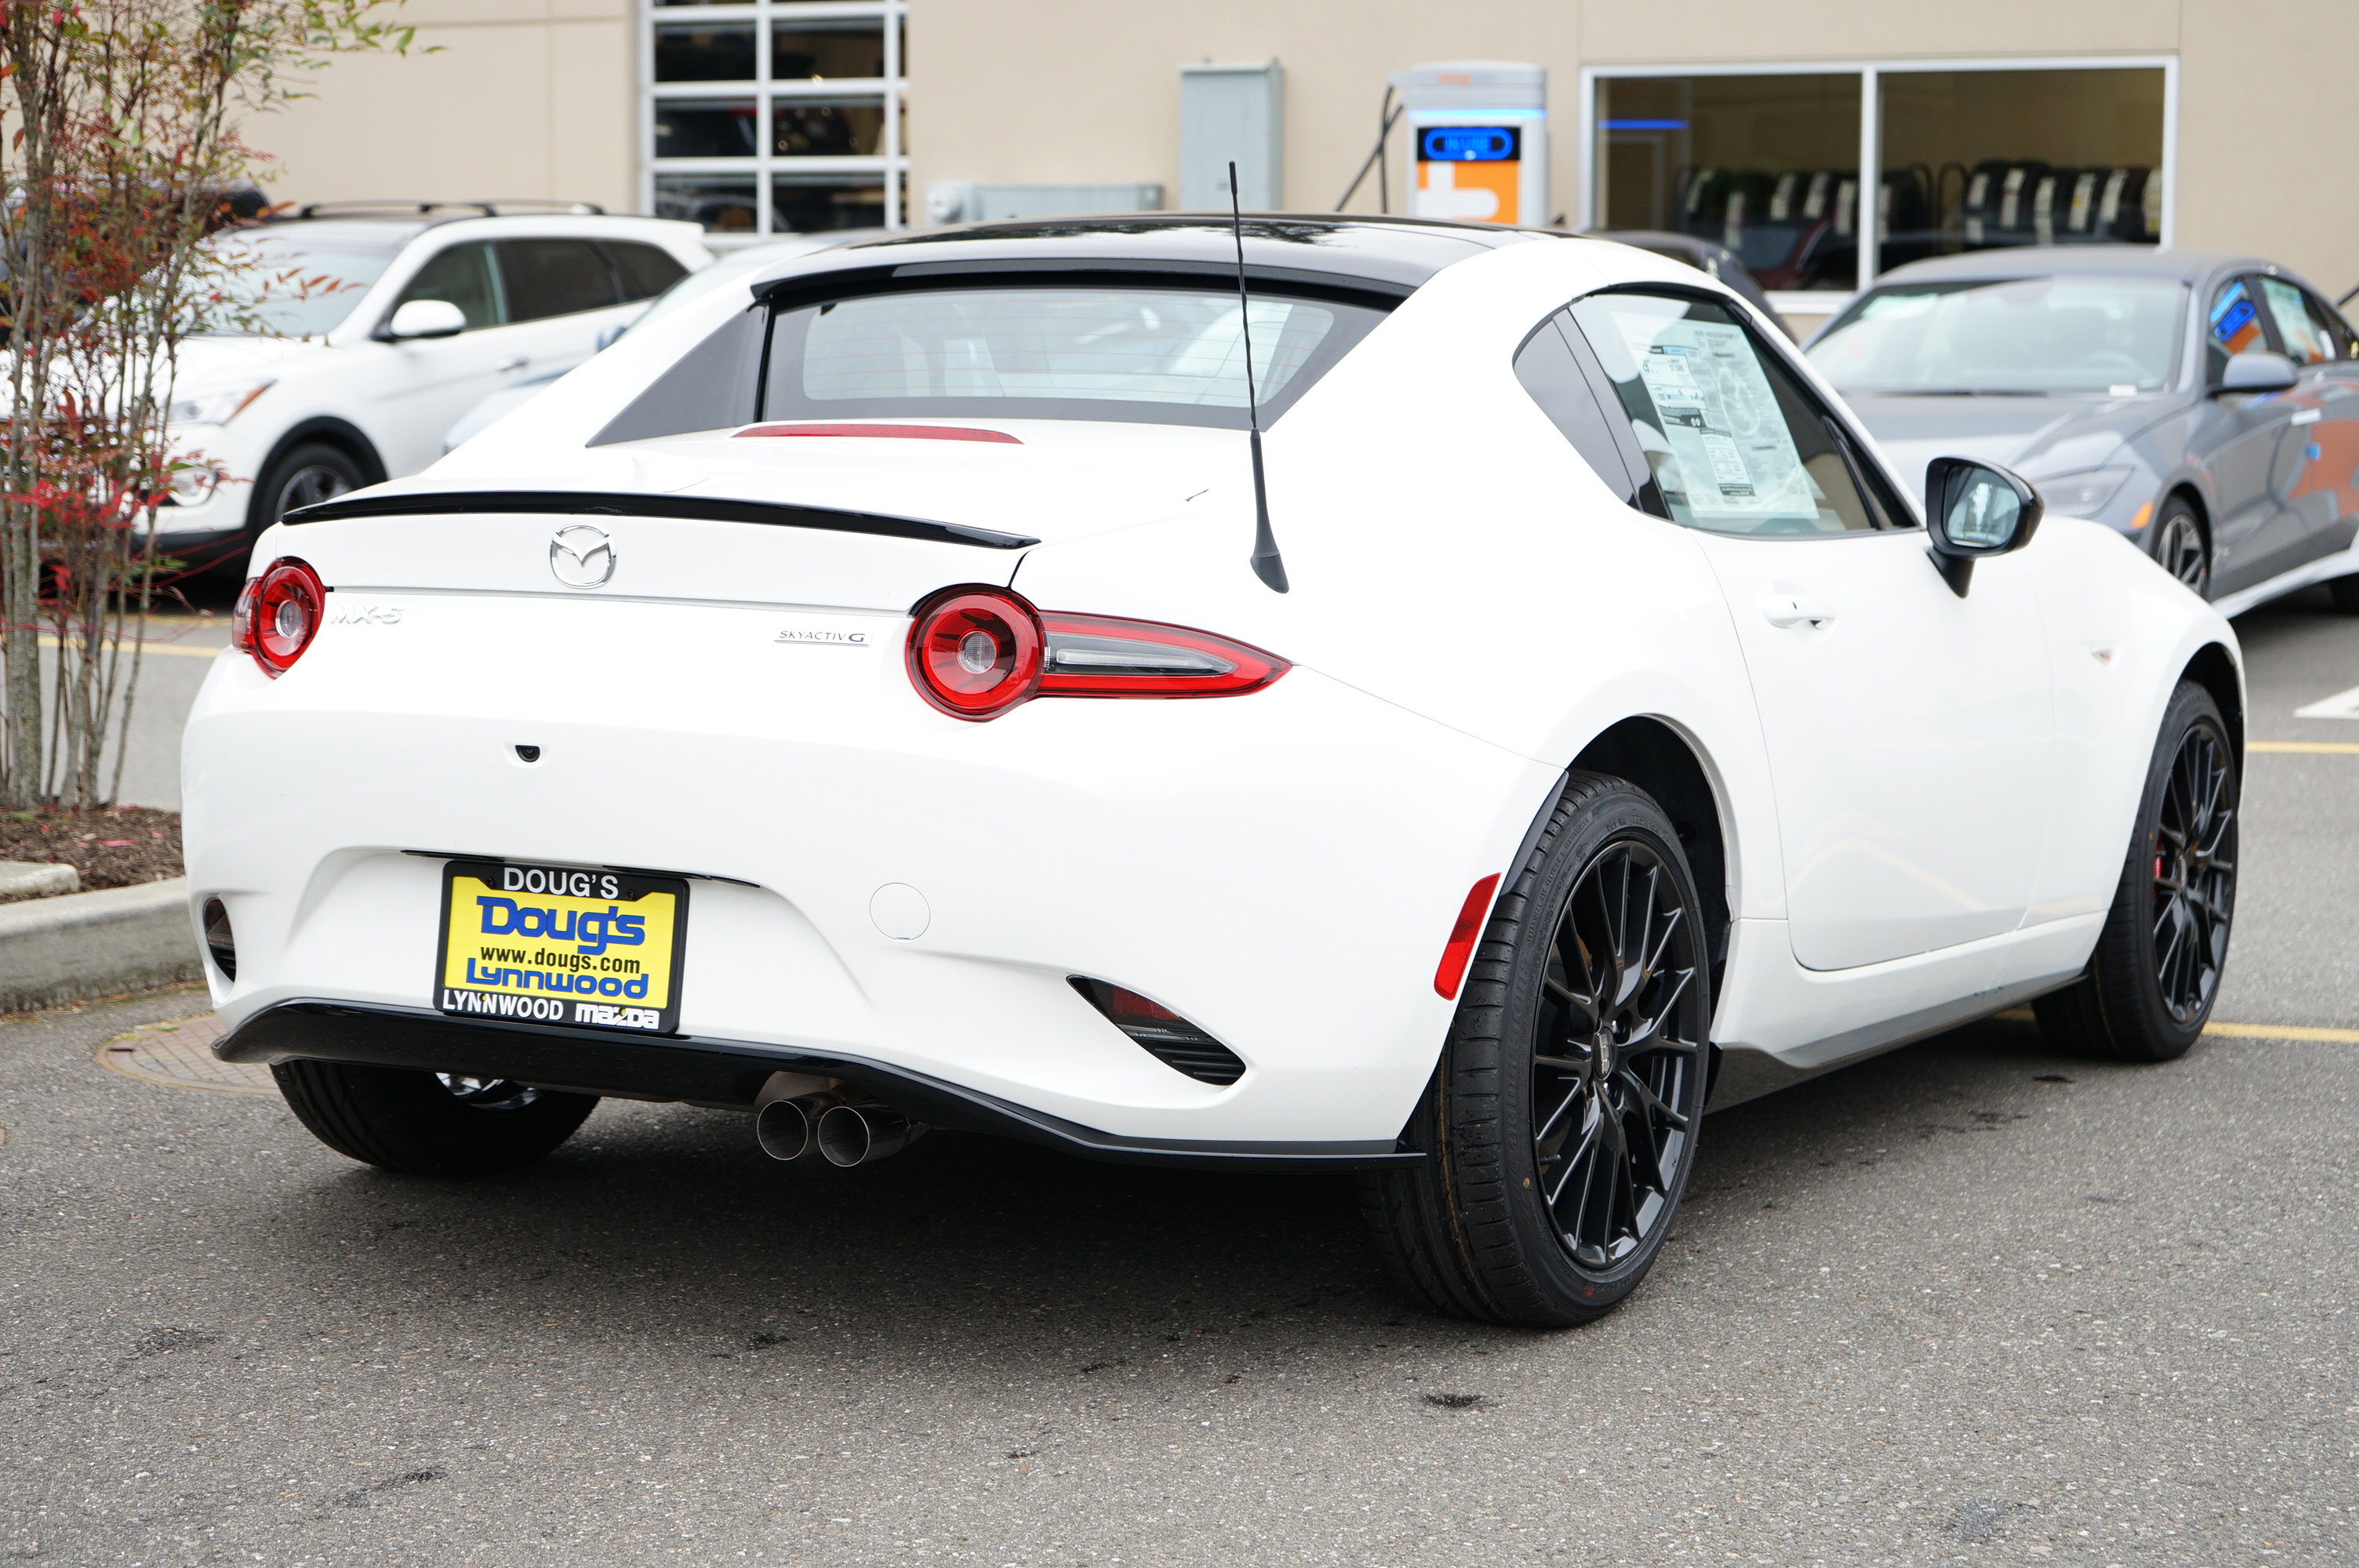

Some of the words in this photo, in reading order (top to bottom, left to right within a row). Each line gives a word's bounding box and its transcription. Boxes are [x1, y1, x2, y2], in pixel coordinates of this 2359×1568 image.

[503, 866, 619, 900] DOUG'S
[480, 946, 641, 974] www.dougs.com
[466, 957, 649, 1000] Lynnwood
[442, 989, 564, 1020] LYNNWOOD
